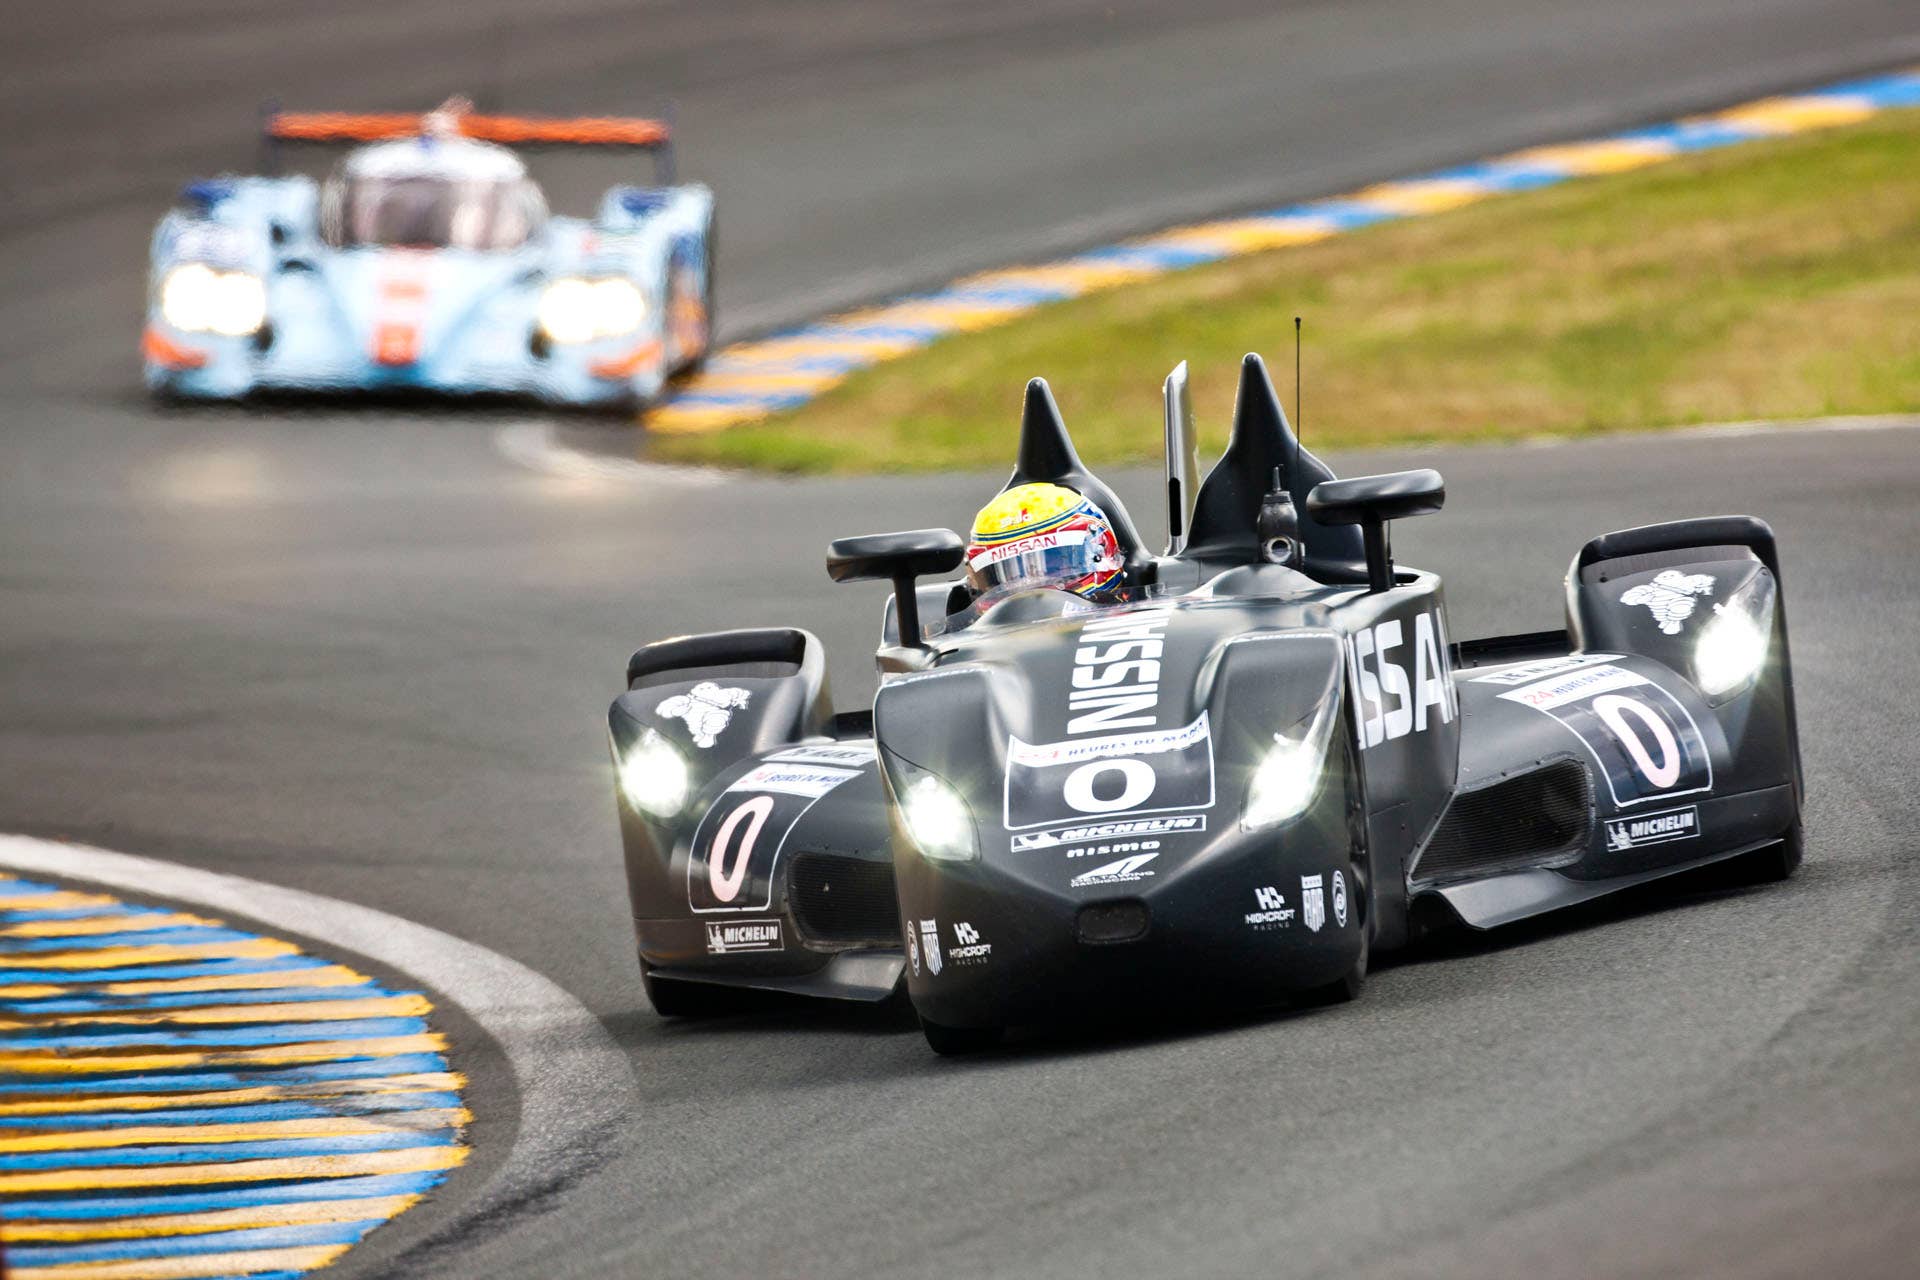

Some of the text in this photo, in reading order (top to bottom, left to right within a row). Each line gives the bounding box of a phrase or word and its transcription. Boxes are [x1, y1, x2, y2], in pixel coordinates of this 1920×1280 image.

[991, 535, 1057, 561] NISSAN
[1592, 694, 1680, 789] 0
[1063, 758, 1156, 813] 0
[1061, 818, 1198, 840] MICHELIN
[1631, 812, 1694, 837] MICHELIN
[709, 795, 774, 902] 0
[1245, 909, 1295, 924] HIGHCROFT
[724, 925, 778, 942] MICHELIN
